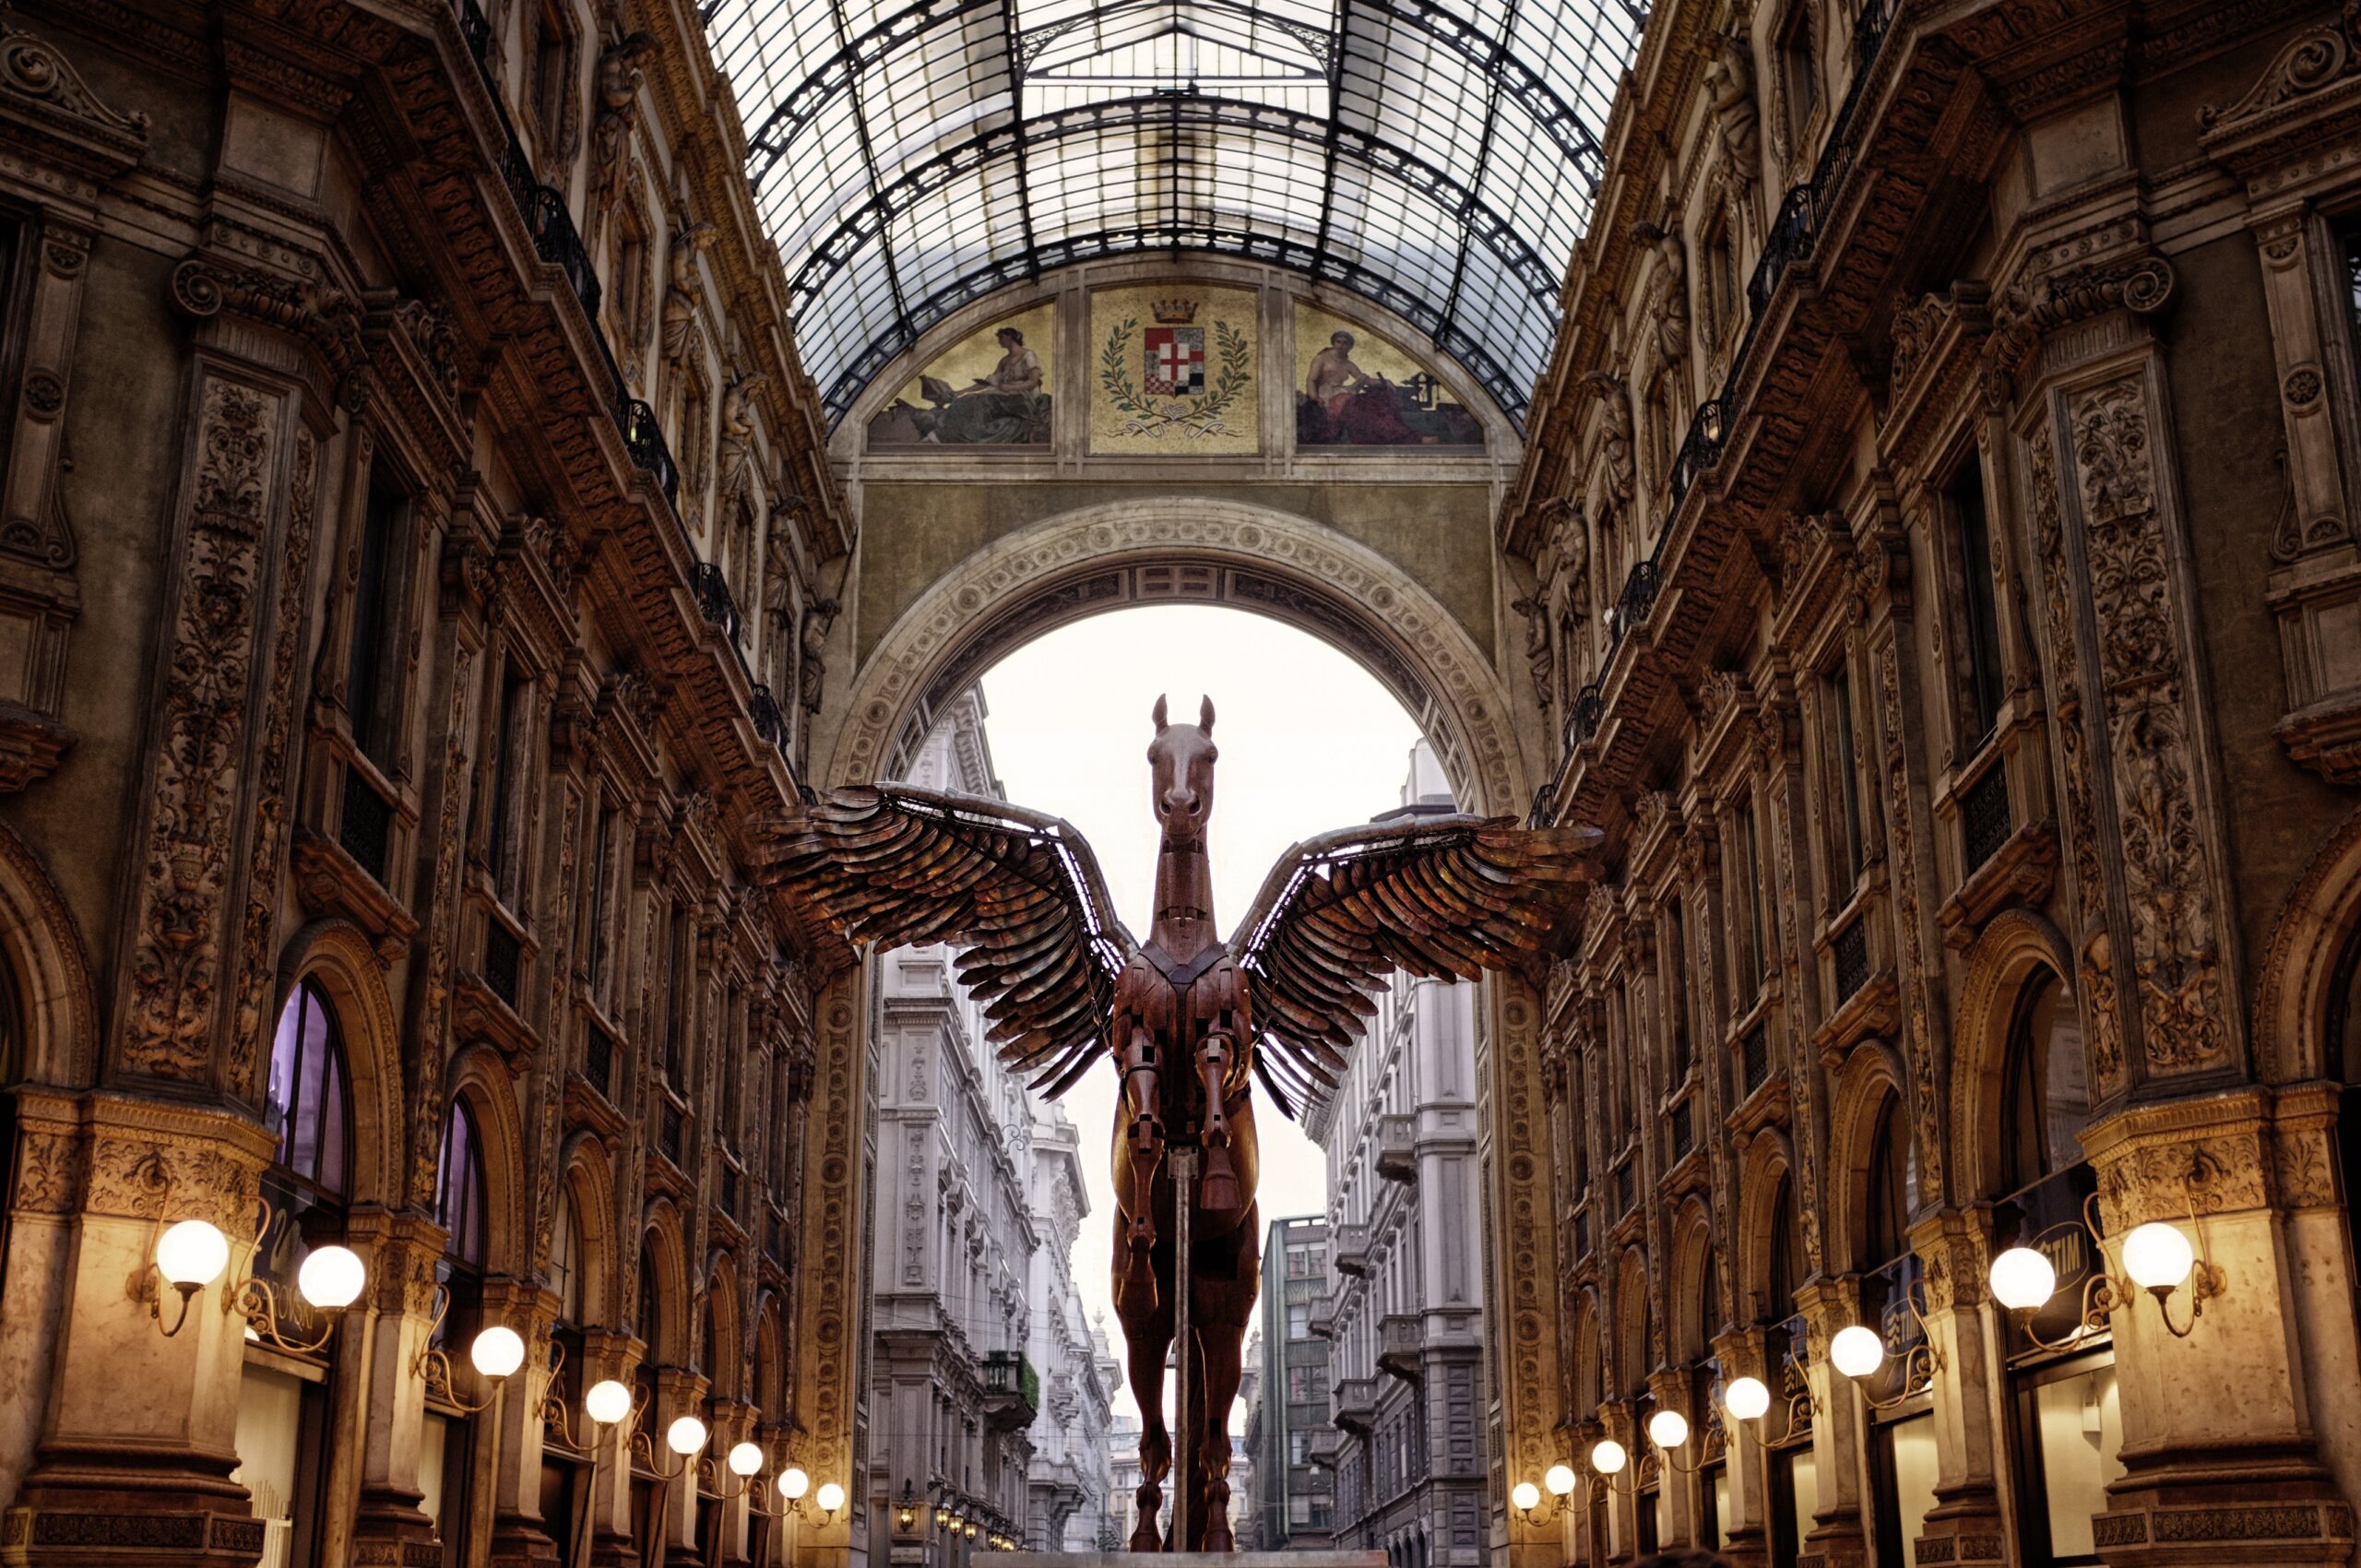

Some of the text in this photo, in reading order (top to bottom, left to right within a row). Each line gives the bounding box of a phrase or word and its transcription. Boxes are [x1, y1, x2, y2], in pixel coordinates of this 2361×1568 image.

[2051, 1230, 2081, 1278] TIM
[251, 1273, 314, 1333] WAROVSKI
[1900, 1309, 1919, 1343] TIM
